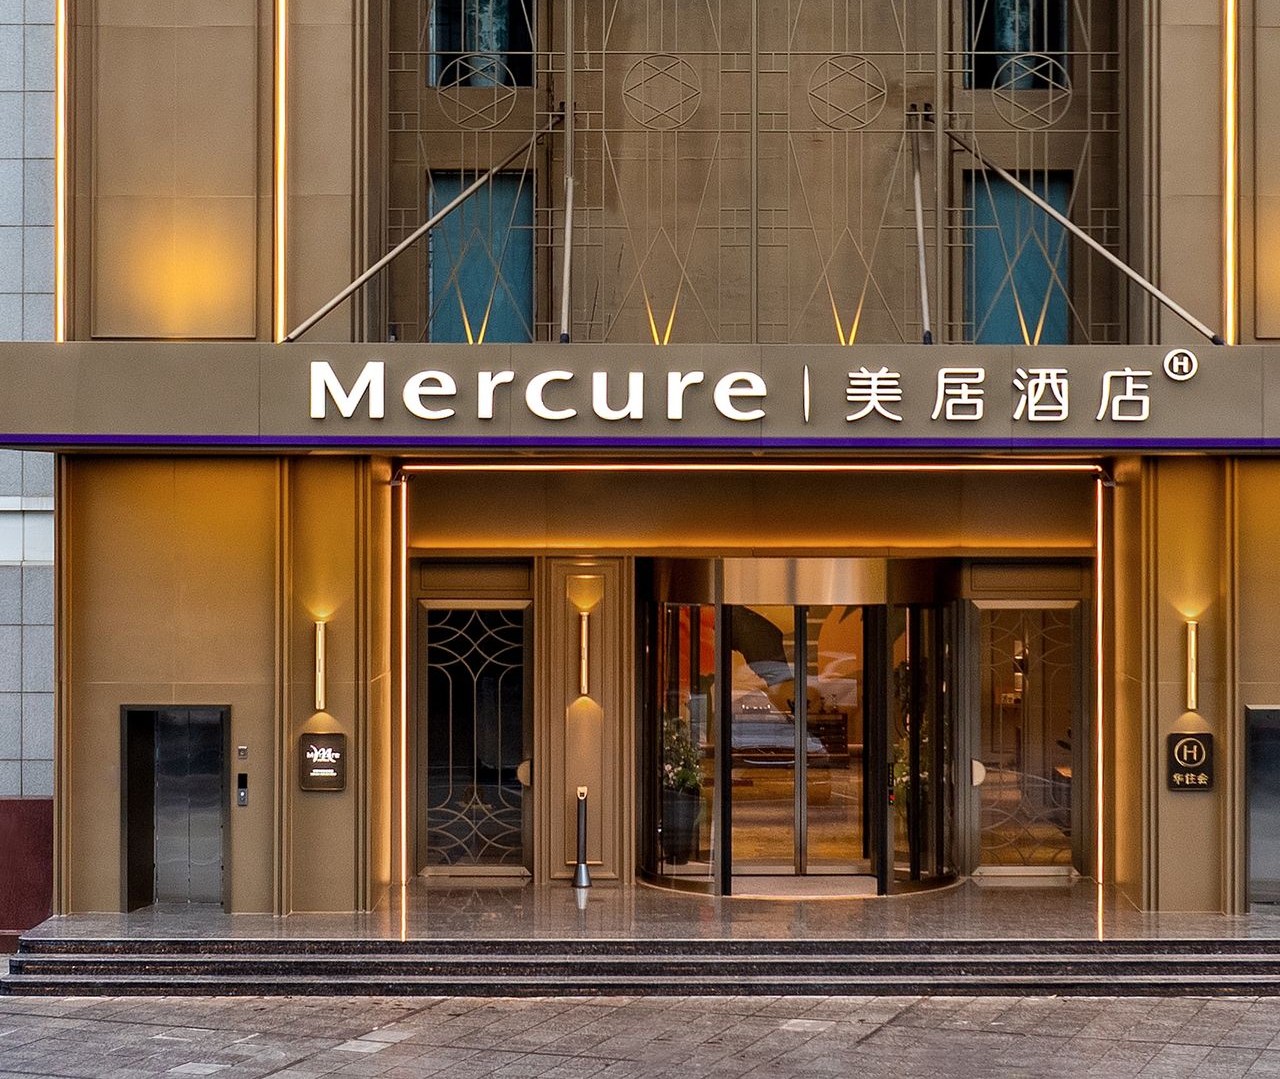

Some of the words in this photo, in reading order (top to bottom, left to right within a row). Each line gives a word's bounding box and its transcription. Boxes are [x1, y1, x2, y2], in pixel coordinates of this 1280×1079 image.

[310, 360, 768, 421] Mercure
[845, 365, 1154, 422] 美居酒店
[1173, 773, 1209, 785] 华住会
